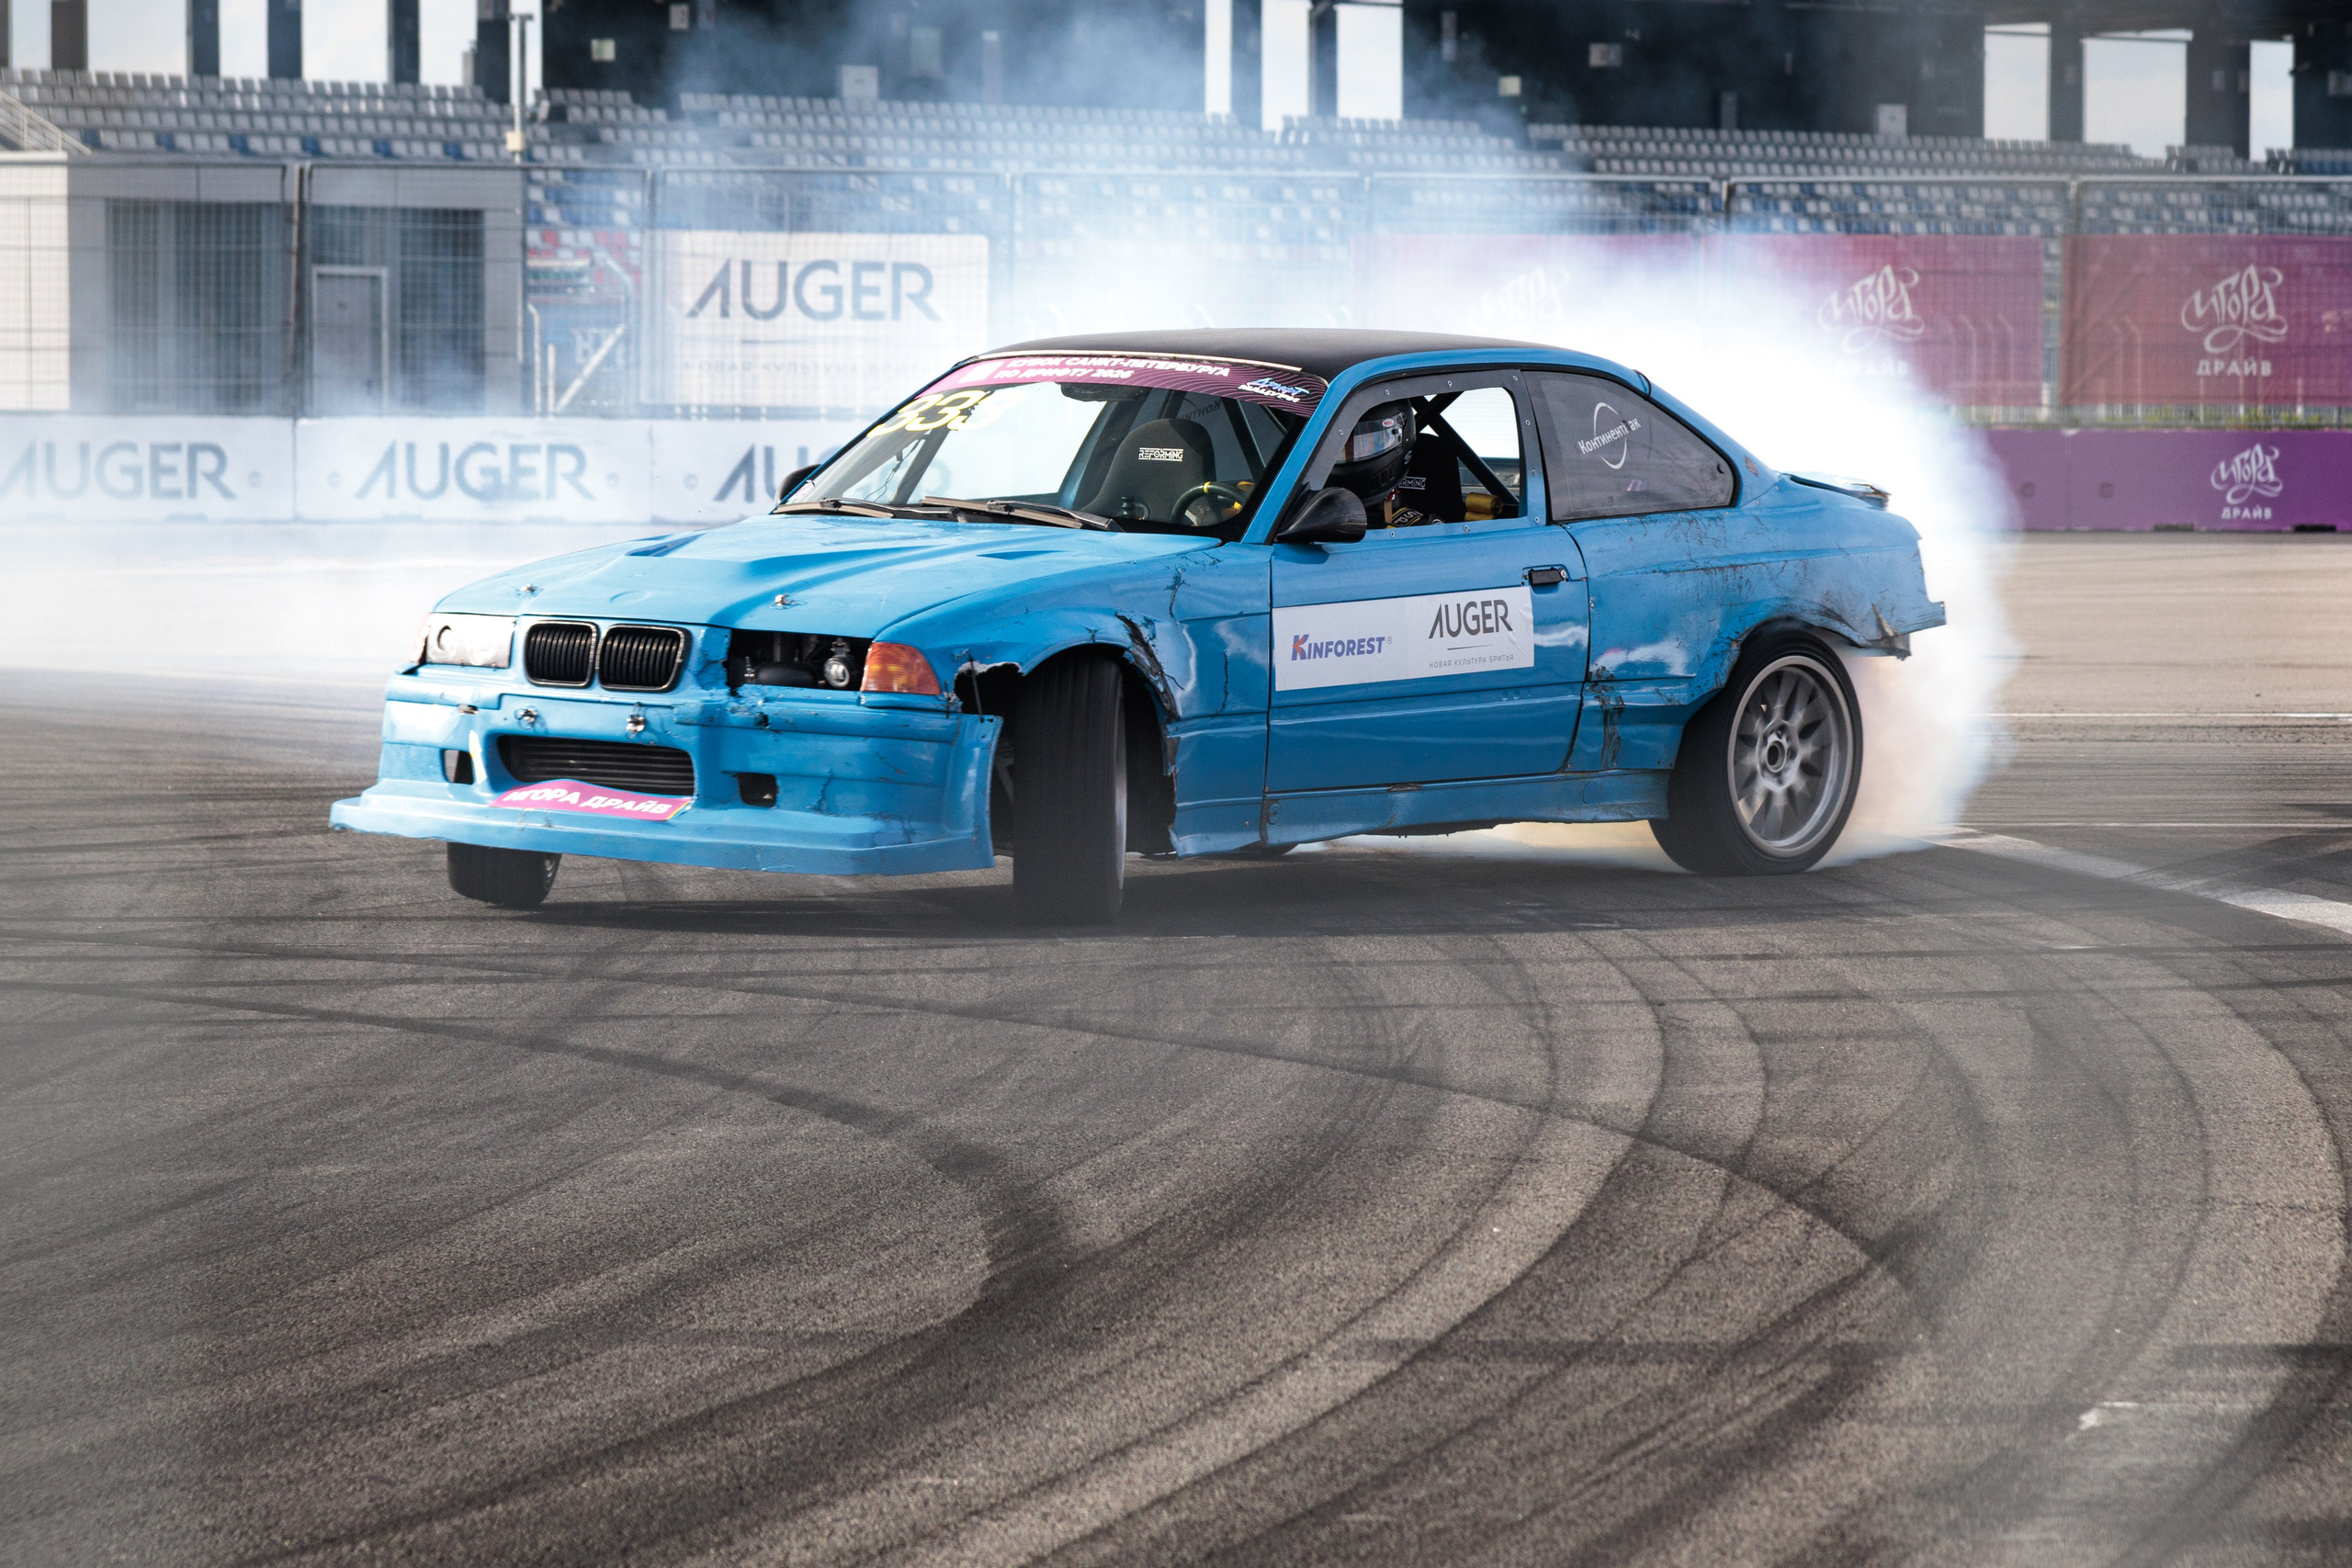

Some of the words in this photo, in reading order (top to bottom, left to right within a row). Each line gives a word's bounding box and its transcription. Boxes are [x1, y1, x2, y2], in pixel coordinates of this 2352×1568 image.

[686, 256, 944, 322] AUGER
[2181, 264, 2289, 354] ИГОРА
[992, 369, 1021, 379] ПО
[1017, 368, 1095, 379] ДРИФТУ
[1006, 357, 1066, 368] КУБОК
[2195, 355, 2273, 378] ДРАЙВ
[0, 438, 237, 502] AUGER
[355, 438, 595, 502] AUGER
[2211, 443, 2283, 505] ИГОРА
[2222, 504, 2273, 520] ДРАЙВ
[1429, 599, 1513, 638] AUGER
[1429, 660, 1452, 669] НОВАЯ
[1454, 657, 1487, 666] КУЛЬТУРА
[1489, 653, 1514, 662] БРИТЬЯ
[503, 788, 581, 805] ИГОРА
[579, 795, 673, 814] ДРАЙВ
